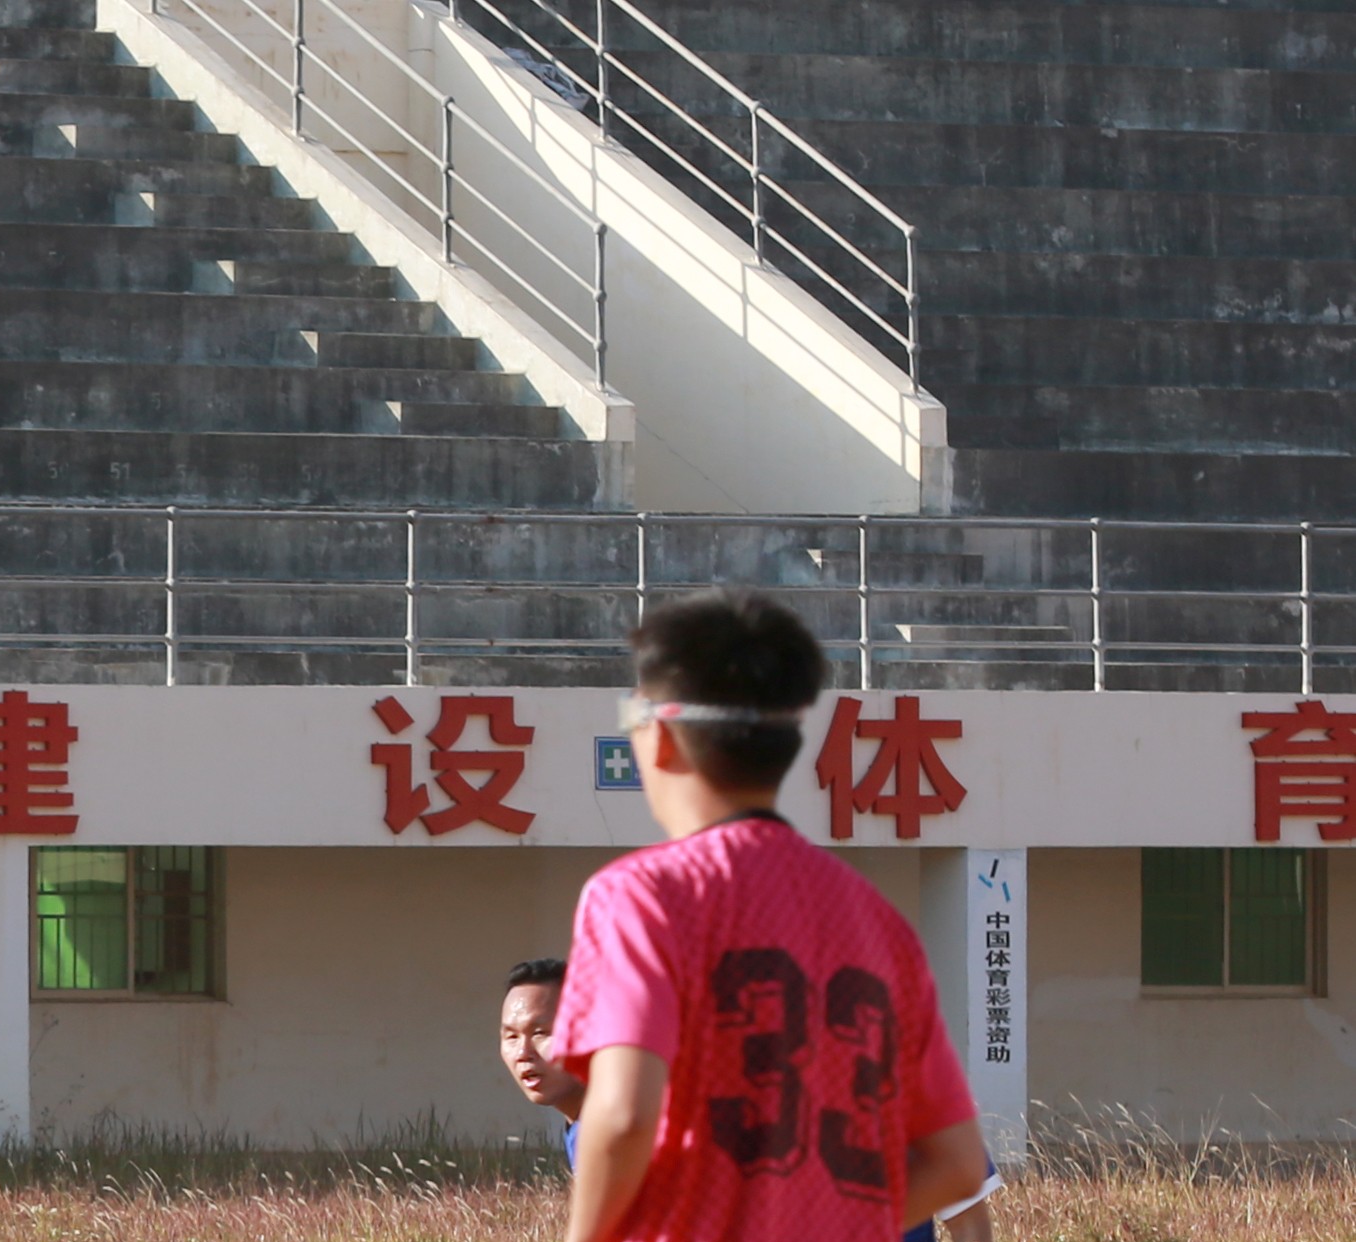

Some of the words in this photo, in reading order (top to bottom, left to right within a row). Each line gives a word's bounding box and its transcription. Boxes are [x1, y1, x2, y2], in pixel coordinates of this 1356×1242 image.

[986, 911, 1011, 1063] 中国体育彩票资助
